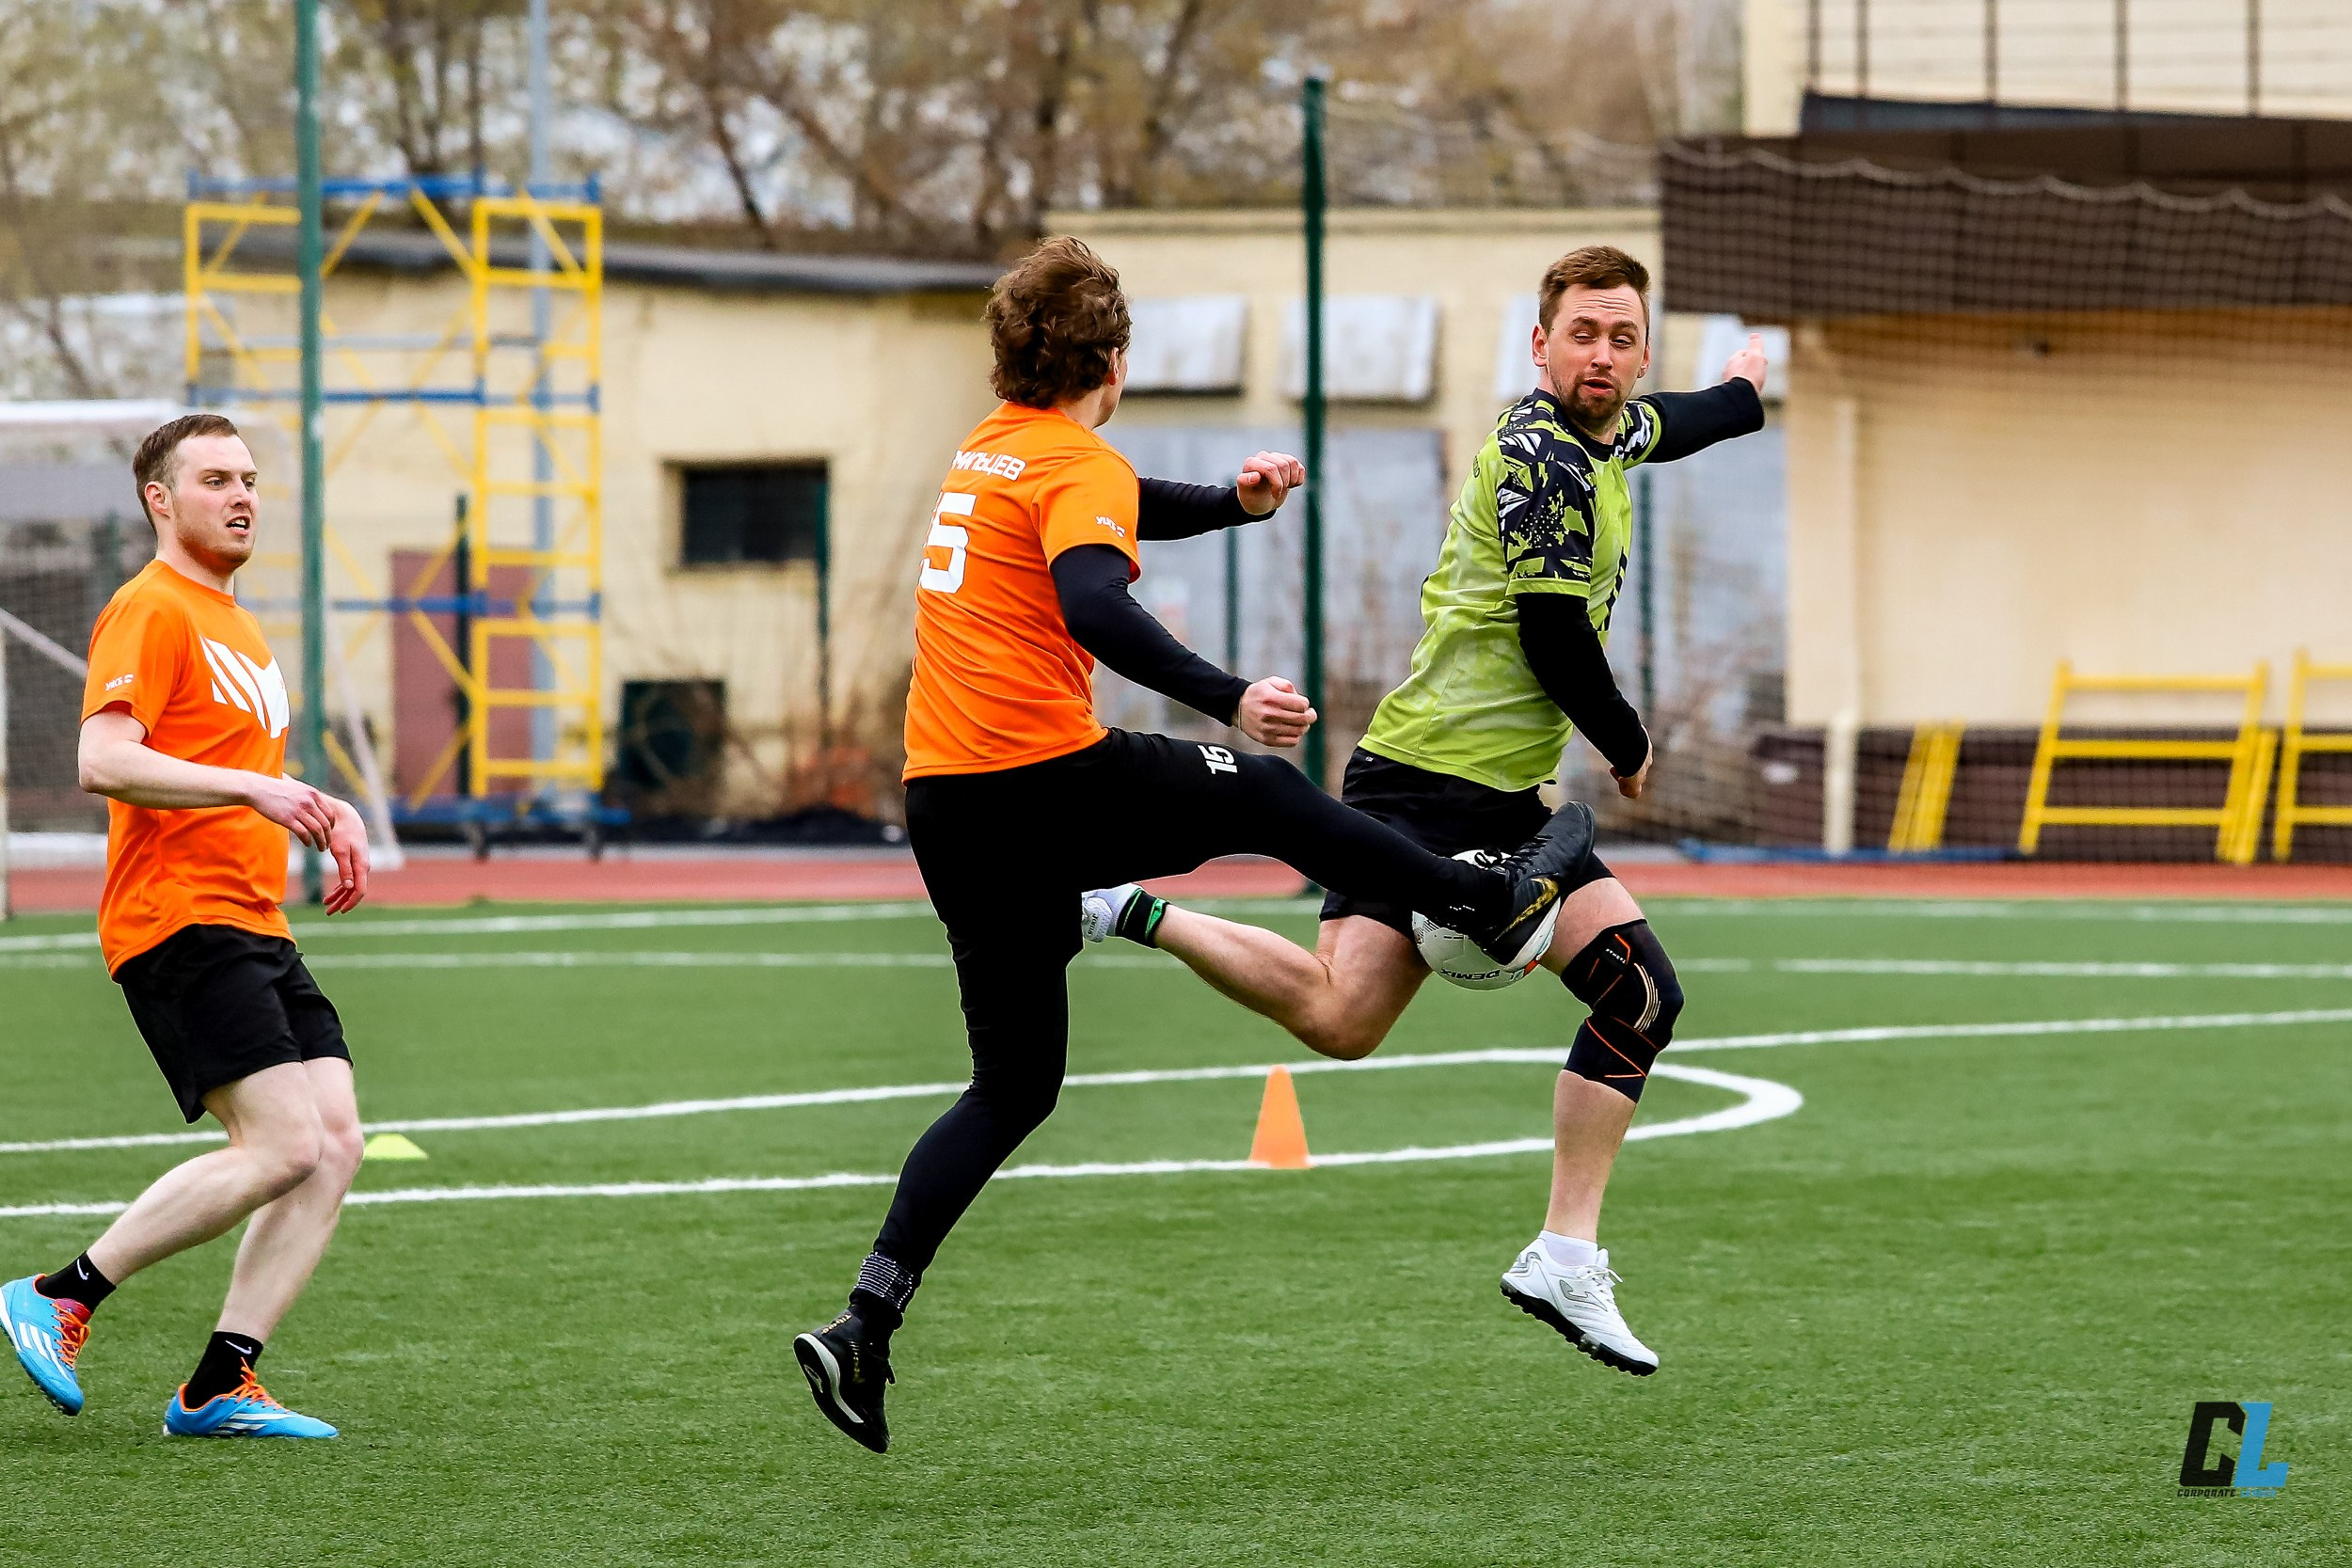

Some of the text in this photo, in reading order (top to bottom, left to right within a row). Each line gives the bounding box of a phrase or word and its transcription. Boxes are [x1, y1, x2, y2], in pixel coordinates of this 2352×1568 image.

[918, 492, 978, 594] 5
[1197, 744, 1238, 775] 15
[1441, 968, 1502, 980] DEMIX
